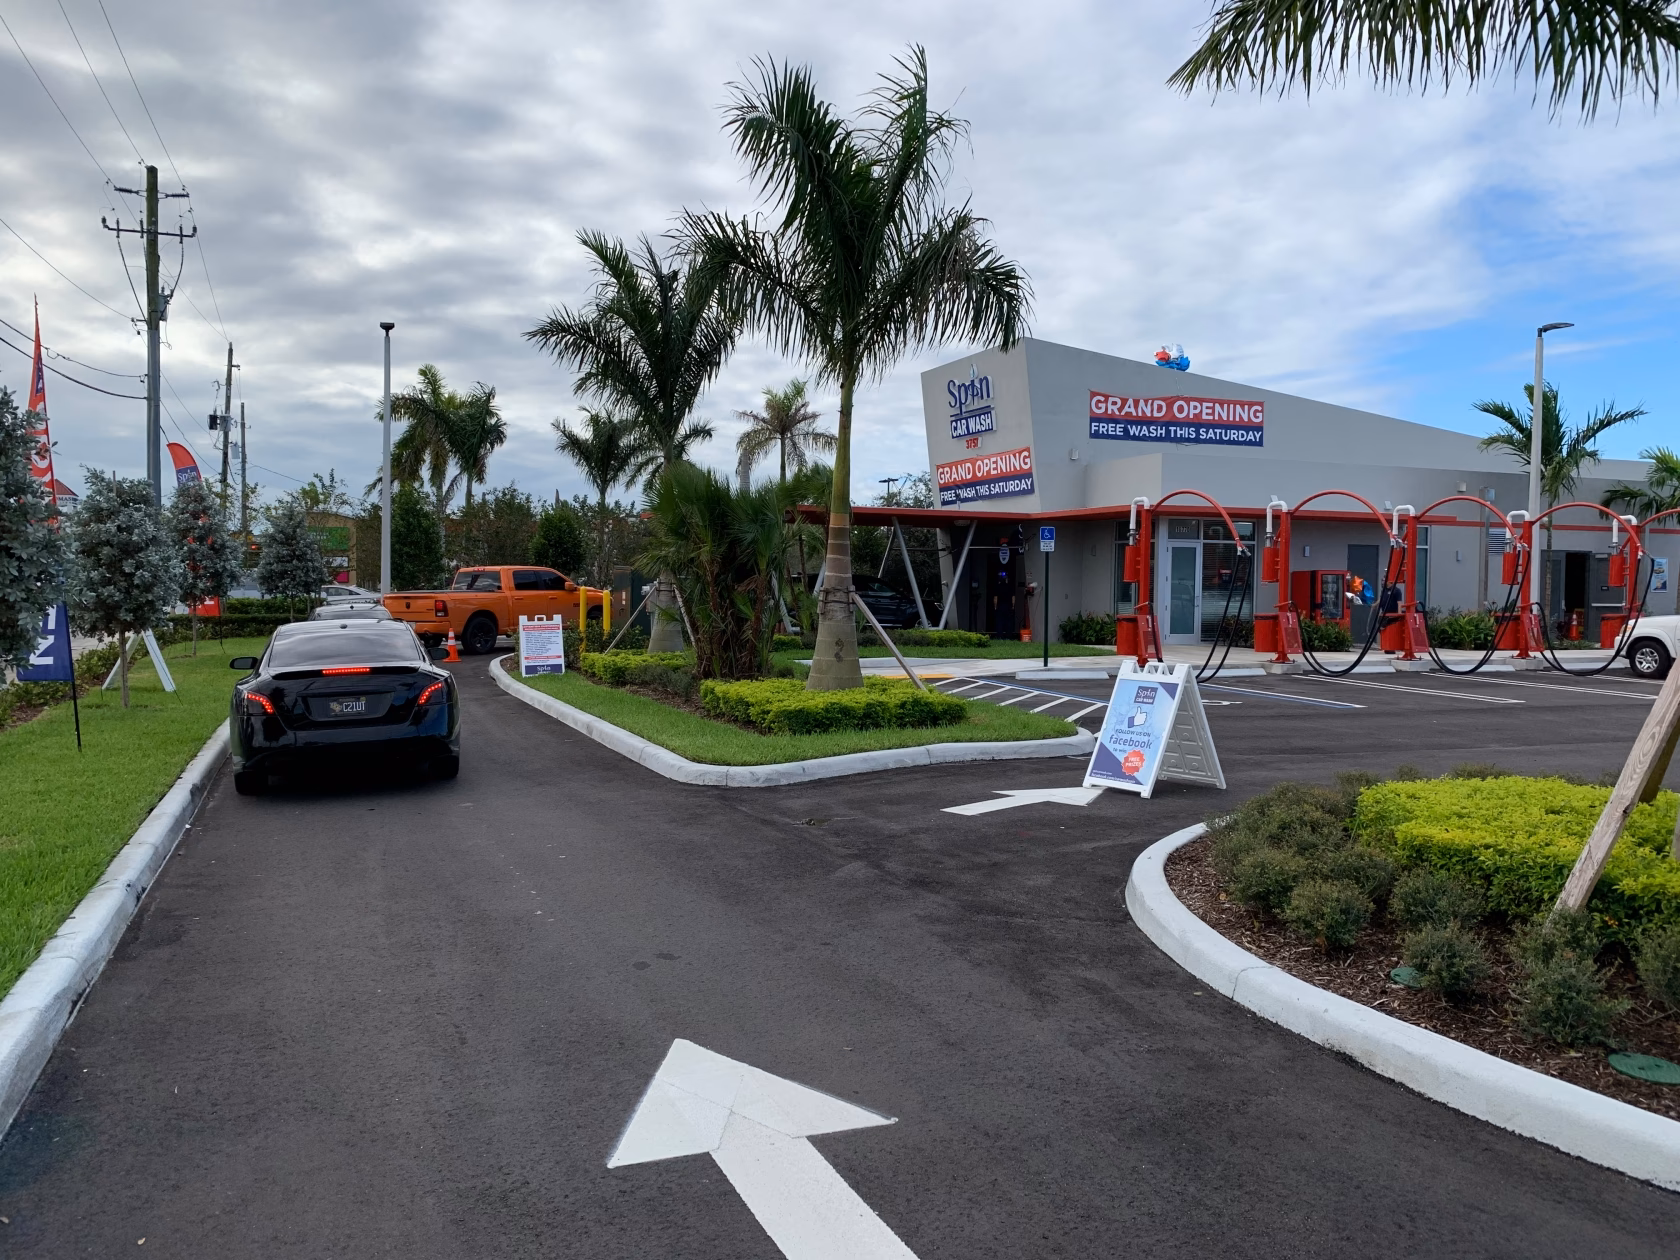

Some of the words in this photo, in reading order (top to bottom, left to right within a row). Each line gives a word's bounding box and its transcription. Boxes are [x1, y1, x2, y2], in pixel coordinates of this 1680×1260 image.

[947, 368, 991, 414] Spin
[1091, 395, 1167, 418] GRAND
[1173, 400, 1263, 423] OPENING
[951, 419, 968, 438] CAR
[968, 412, 992, 435] WASH
[1091, 422, 1124, 436] FREE
[1127, 425, 1166, 438] WASH
[1169, 426, 1196, 439] THIS
[1199, 428, 1262, 442] SATURDAY
[937, 464, 973, 485] GRAND
[975, 451, 1031, 477] OPENING
[940, 490, 957, 502] FREE
[957, 486, 976, 500] WASH
[976, 484, 990, 496] THIS
[990, 477, 1033, 495] SATURDAY
[1137, 688, 1156, 699] Spin
[1108, 734, 1153, 750] facebook
